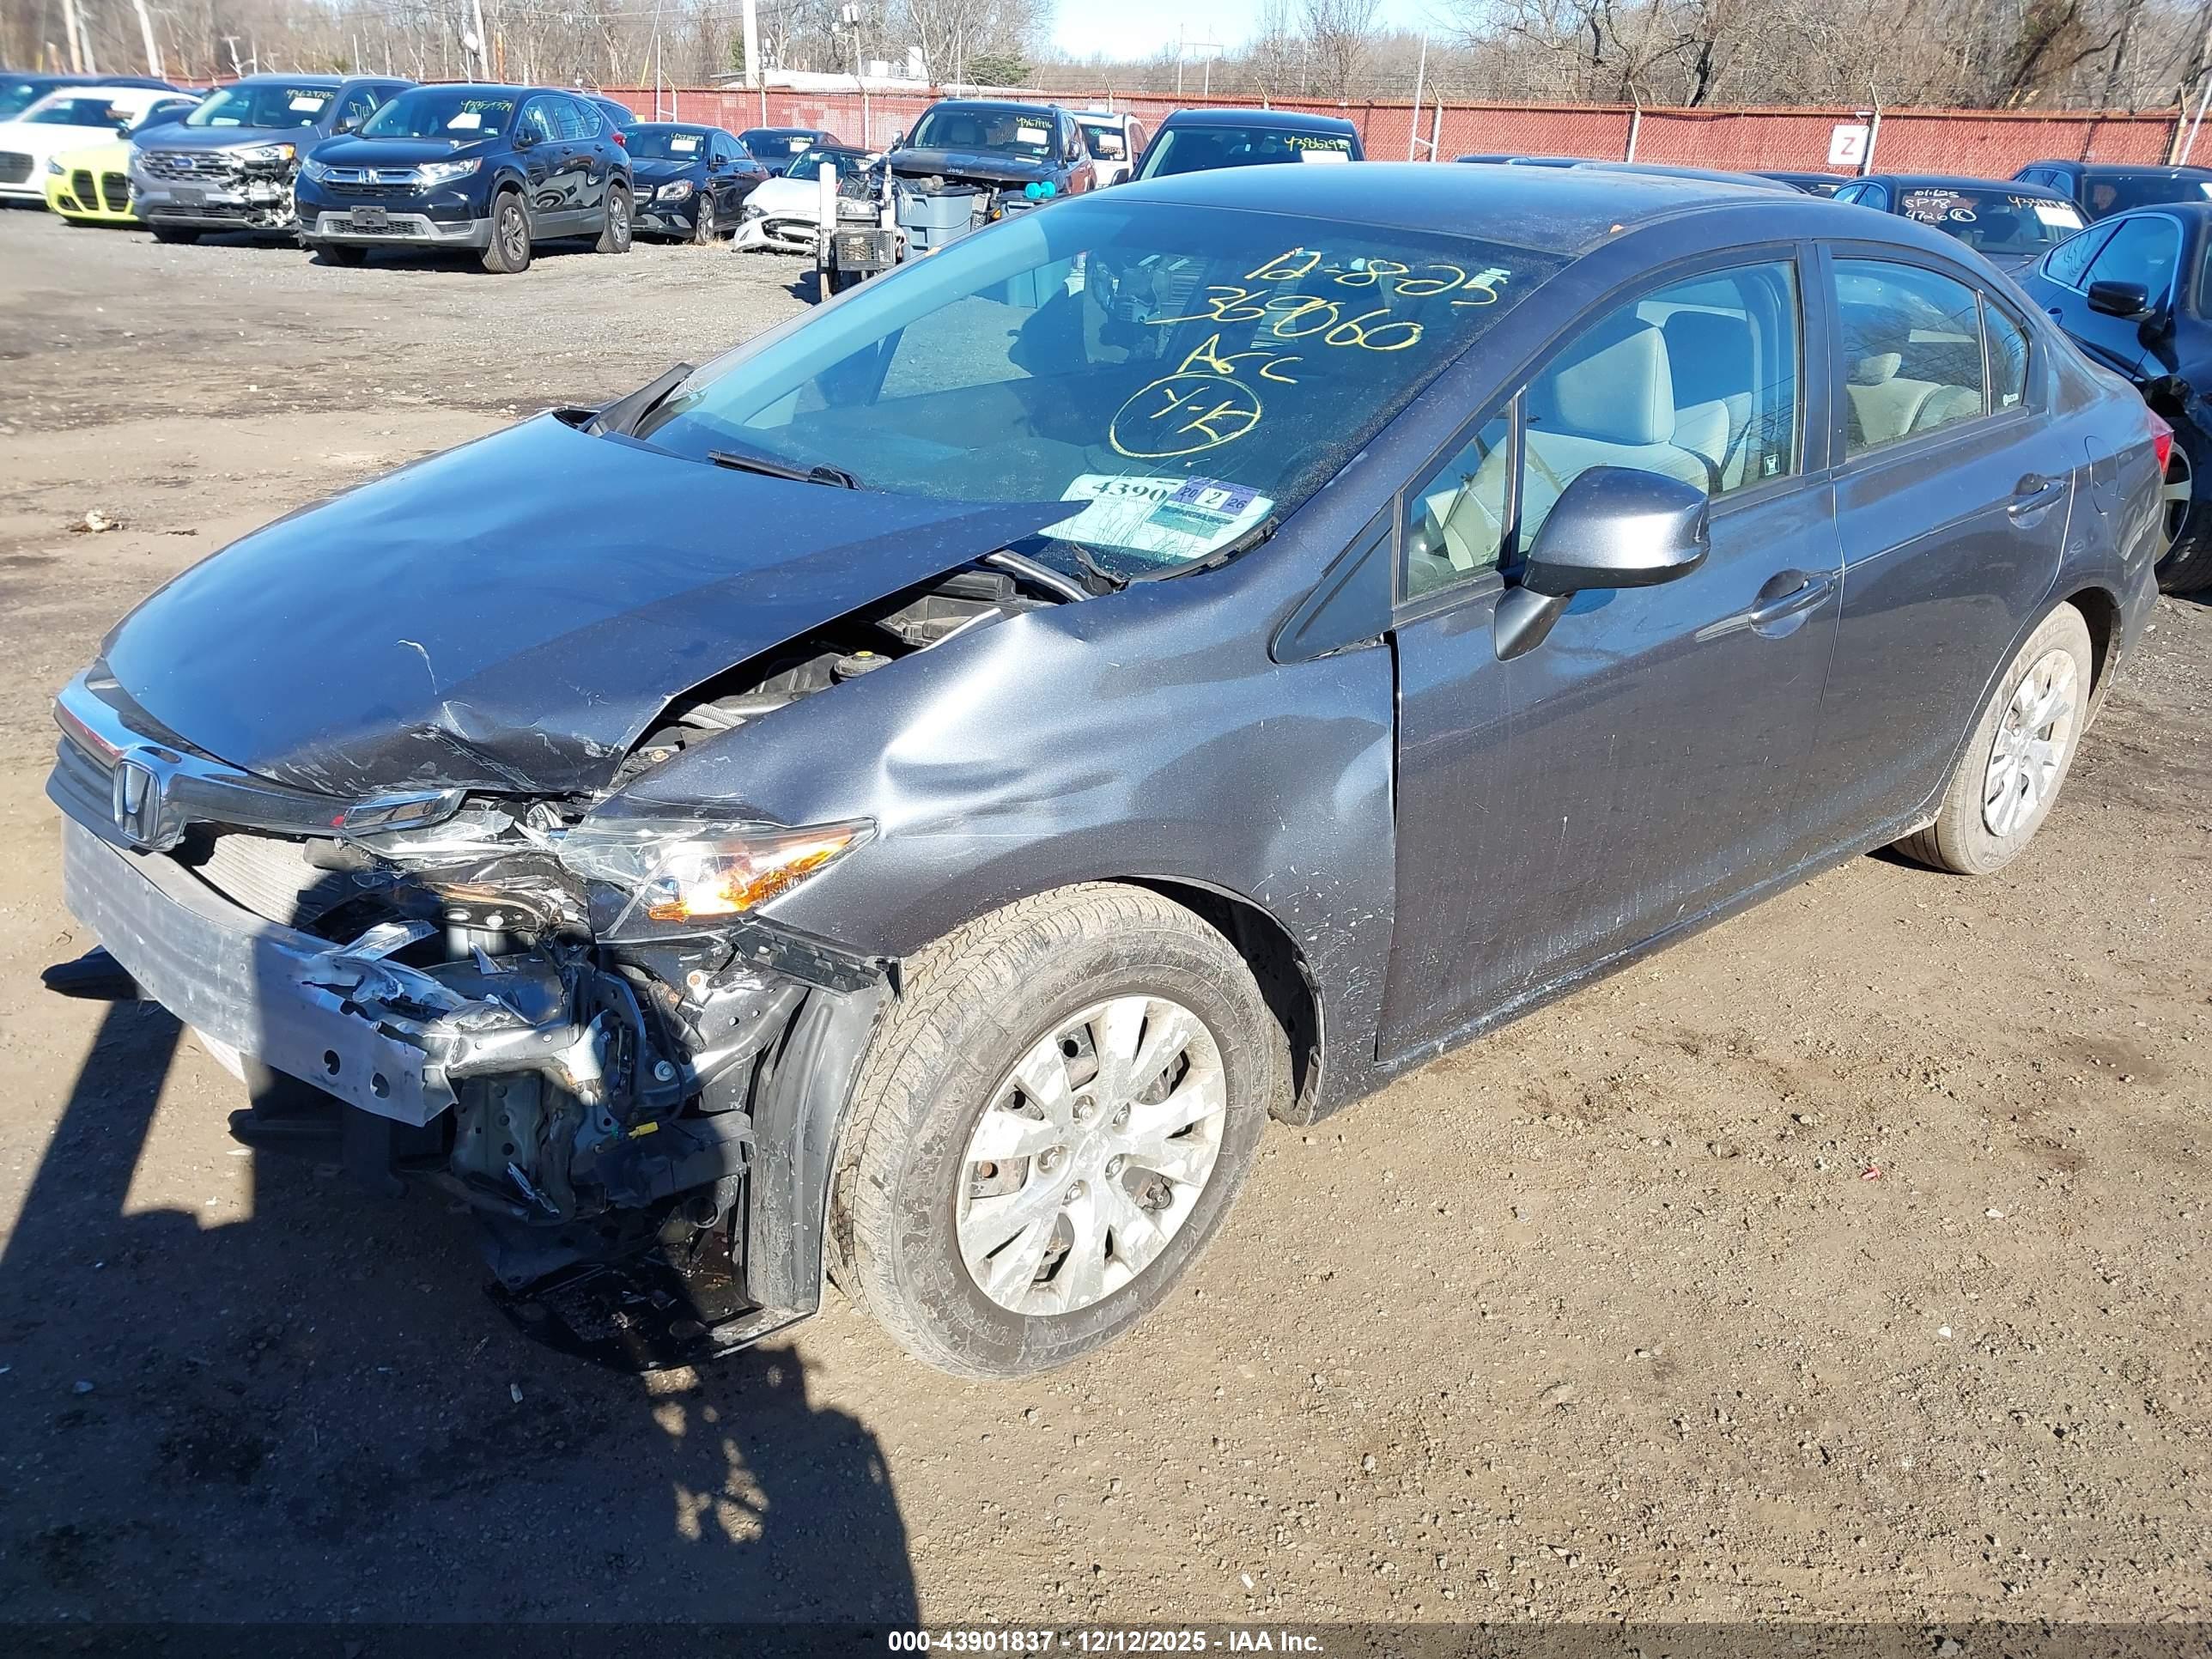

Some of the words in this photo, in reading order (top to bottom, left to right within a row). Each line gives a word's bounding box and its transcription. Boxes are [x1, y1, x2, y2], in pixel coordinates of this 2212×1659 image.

[1840, 137, 1856, 155] Z
[946, 167, 964, 175] Jeep
[1905, 210, 1948, 221] 4726
[1179, 487, 1199, 499] 20
[1205, 491, 1223, 504] 2
[1226, 498, 1248, 509] 26
